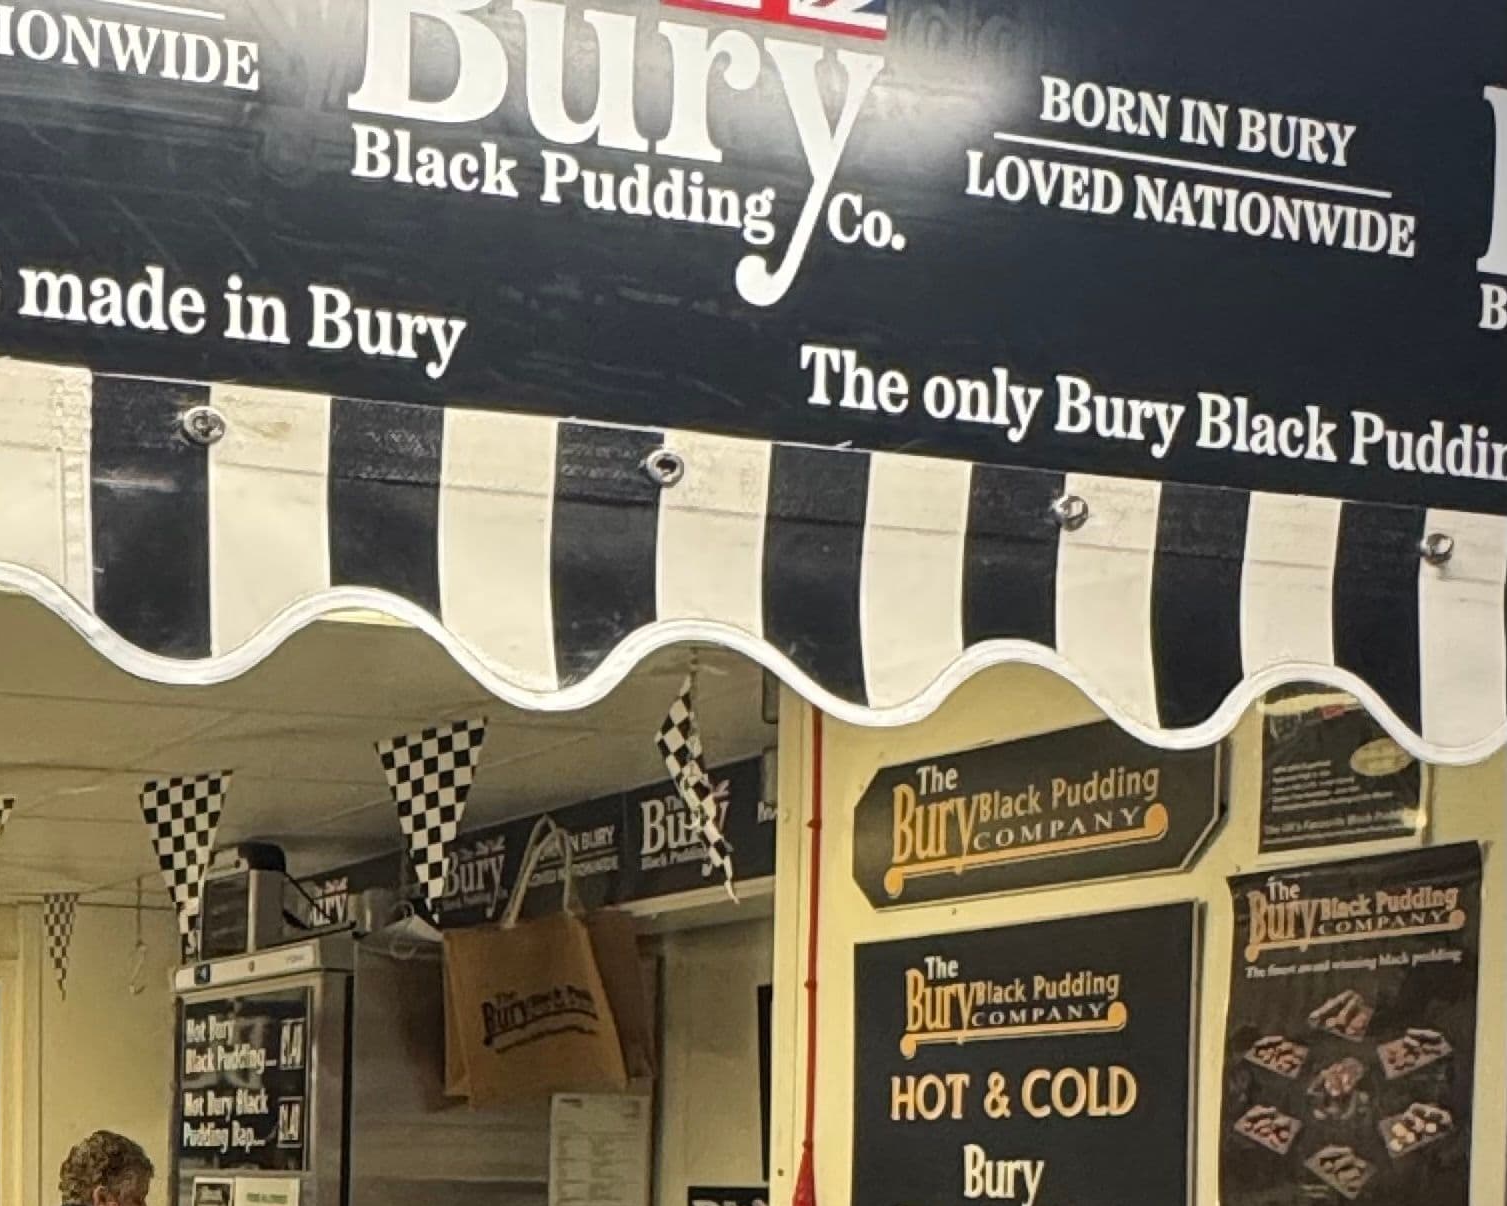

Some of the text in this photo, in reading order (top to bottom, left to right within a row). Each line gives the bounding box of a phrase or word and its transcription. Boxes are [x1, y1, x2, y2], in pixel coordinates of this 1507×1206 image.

[348, 0, 885, 306] Bury
[1039, 76, 1357, 167] BORN IN BURY
[350, 123, 906, 250] Black Pudding Co.
[965, 150, 1417, 259] LOVED NATIONWIDE
[19, 266, 208, 337] made
[223, 273, 291, 345] in
[306, 284, 468, 379] Bury
[800, 344, 909, 415] The
[923, 367, 1043, 443] only
[1055, 375, 1186, 458] Bury
[1197, 392, 1339, 464] Black
[916, 765, 959, 797] The
[892, 767, 1160, 876] Bury Black Pudding
[972, 805, 1141, 852] COMPANY
[1246, 890, 1321, 952] Bury
[1375, 887, 1459, 914] Pudding
[1267, 880, 1301, 901] The
[1318, 909, 1446, 936] COMPANY
[924, 956, 960, 980] The
[905, 968, 1121, 1045] Bury Black Pudding
[970, 1001, 1107, 1028] COMPANY
[890, 1066, 1138, 1121] HOT & COLD
